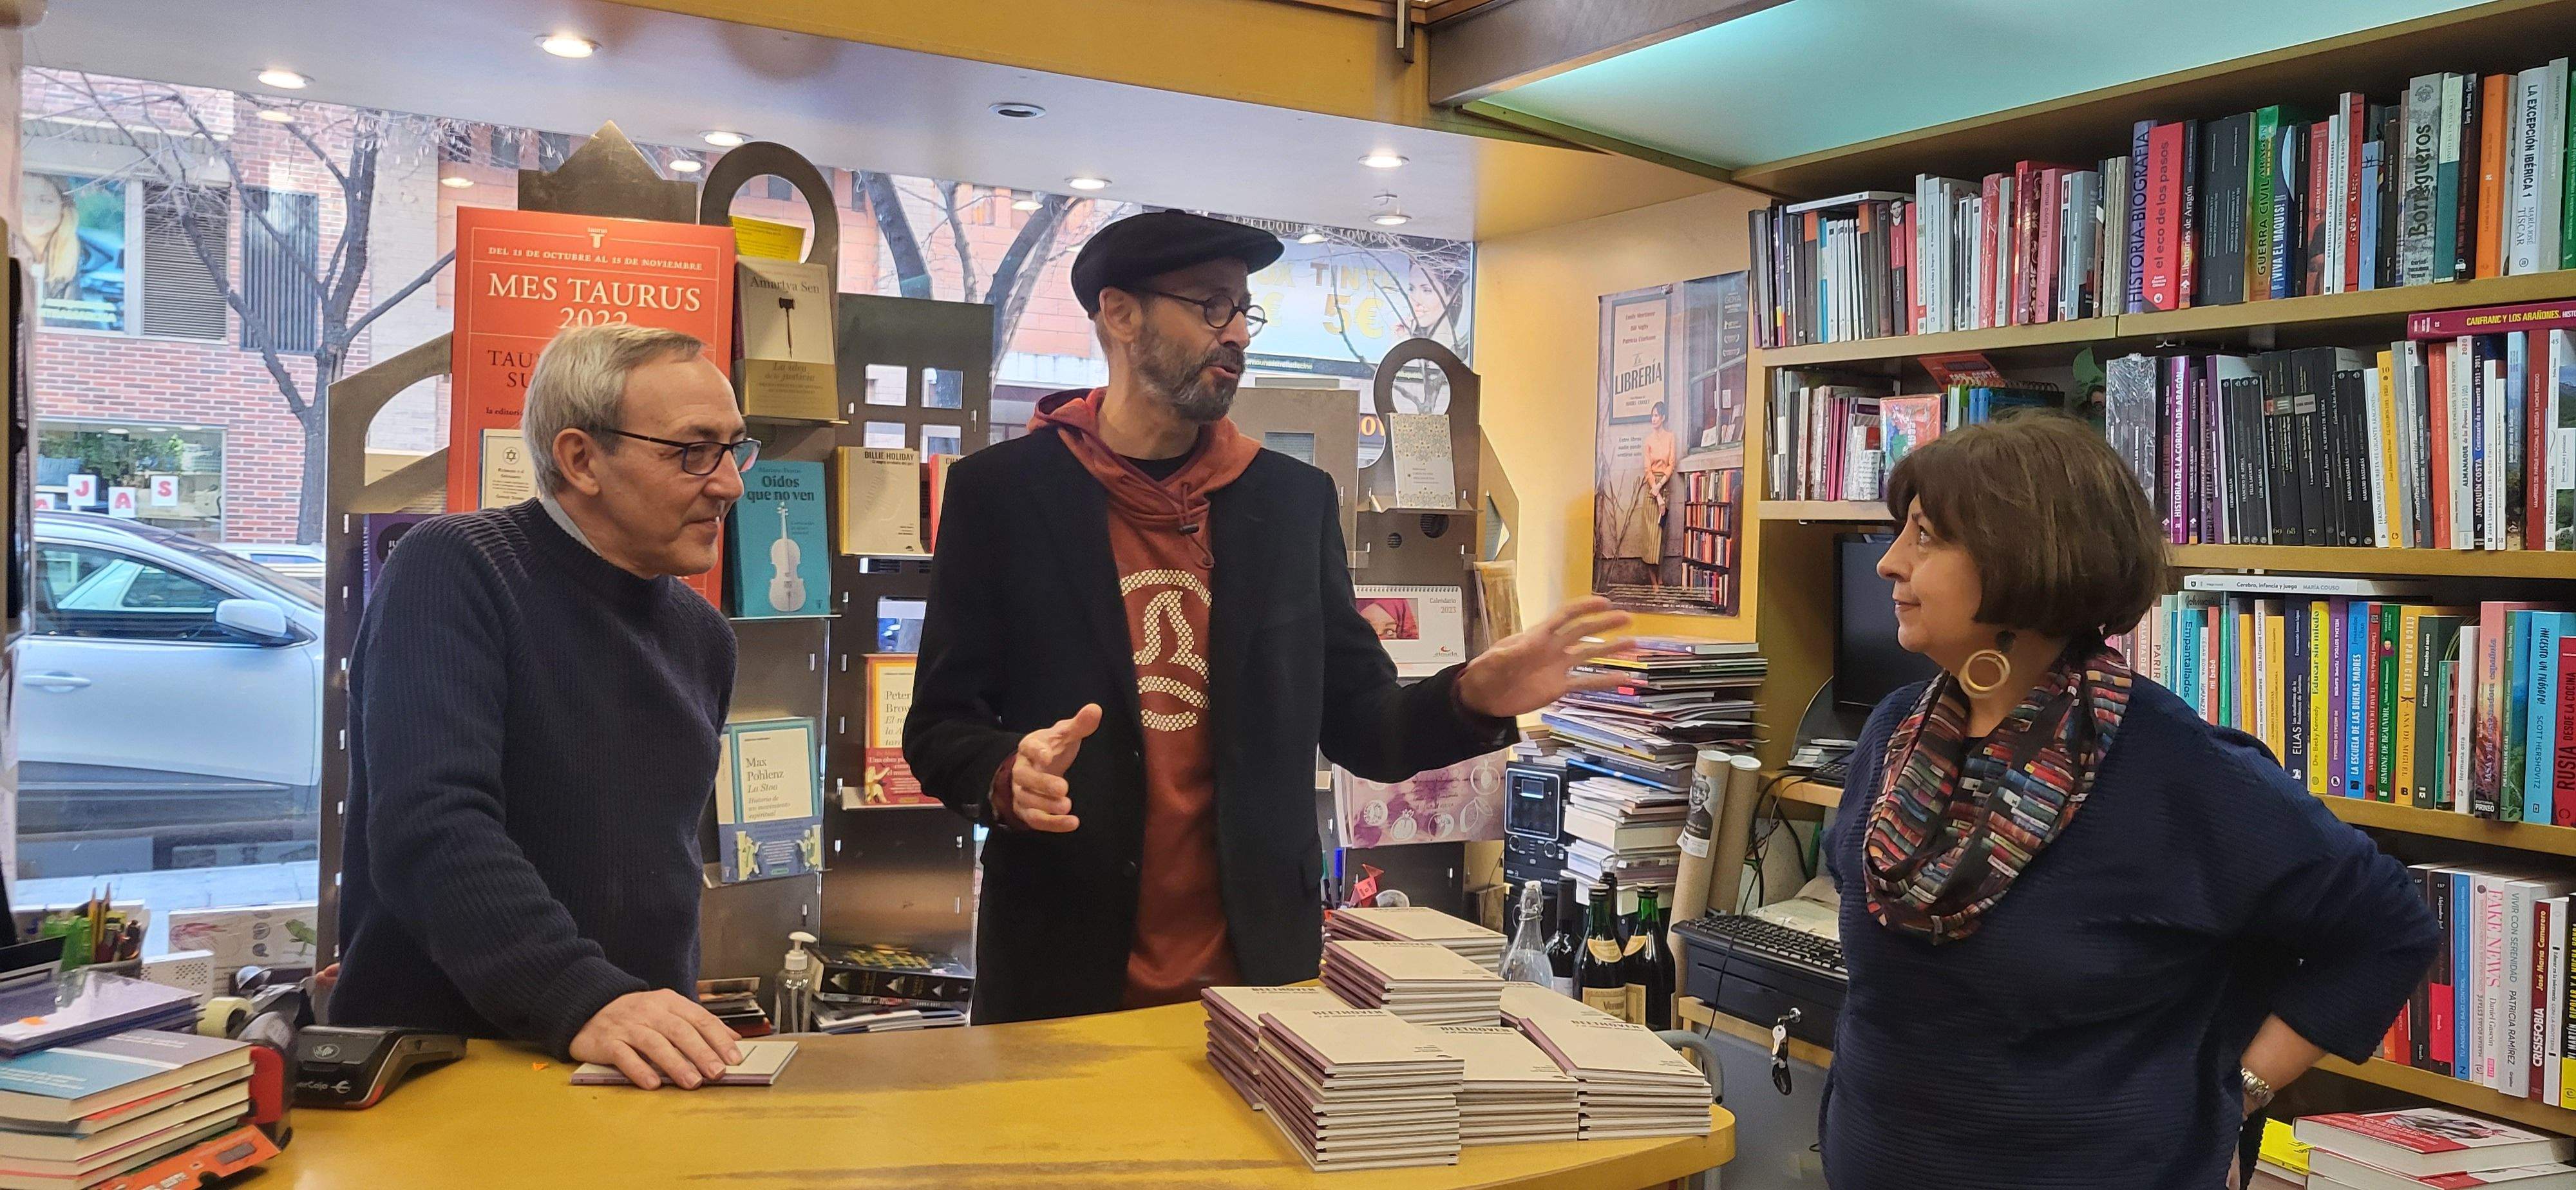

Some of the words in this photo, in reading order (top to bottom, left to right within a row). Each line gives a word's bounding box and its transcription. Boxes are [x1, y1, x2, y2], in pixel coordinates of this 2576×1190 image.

[2527, 84, 2539, 97] LA
[2524, 99, 2538, 151] EXCEPCIÓN
[2159, 141, 2170, 182] pasos
[2259, 126, 2267, 176] ARAGÓN
[2523, 153, 2536, 191] IBÉRICA
[2156, 185, 2167, 205] los
[2184, 185, 2193, 216] Aragón
[2259, 180, 2269, 214] CIVIL
[2128, 131, 2149, 303] HISTORIA-BIOGRAFÍA
[2157, 208, 2166, 225] de
[2184, 218, 2192, 229] de
[2273, 204, 2285, 241] MAQUIS!
[2515, 207, 2526, 246] TÍSCAR
[2156, 228, 2165, 253] eco
[2257, 219, 2268, 275] GUERRA
[2273, 243, 2284, 255] EL
[488, 247, 509, 256] DEL
[526, 249, 540, 258] DE
[543, 251, 591, 262] OCTUBRE
[594, 254, 609, 263] AL
[624, 258, 639, 266] DE
[641, 259, 703, 271] NOVIEMBRE
[2155, 256, 2163, 269] el
[2182, 231, 2192, 276] Libertarios
[2272, 258, 2284, 281] ¡VIVA
[488, 272, 558, 301] MES
[567, 277, 701, 312] TAURUS
[750, 276, 797, 292] Amartya
[800, 280, 820, 294] Sen
[558, 307, 629, 330] 2022
[1615, 359, 1662, 395] LIBRERÍA
[2174, 371, 2183, 410] ARAGÓN
[2175, 411, 2183, 424] DE
[864, 451, 886, 460] BILLIE
[886, 451, 914, 461] HOLIDAY
[2175, 455, 2183, 466] LA
[762, 475, 800, 489] Oídos
[2175, 468, 2182, 479] DE
[74, 481, 90, 496] J
[115, 493, 130, 509] A
[156, 481, 172, 496] S
[747, 489, 771, 504] que
[774, 490, 790, 500] no
[793, 490, 815, 502] ven
[2473, 484, 2483, 518] JOAQUÍN
[2405, 616, 2415, 640] ÉTICA
[2405, 643, 2413, 665] PARA
[2539, 627, 2549, 659] ¡NECESITO
[2141, 657, 2147, 668] DE
[2183, 621, 2193, 698] Empantallados
[2353, 654, 2361, 681] MADRES
[2537, 661, 2547, 671] UN
[2210, 680, 2216, 690] mi
[2403, 668, 2412, 692] CELIA
[2536, 674, 2548, 705] FILÓSOFO!
[2564, 672, 2575, 701] COCINA
[886, 691, 912, 701] Peter
[2352, 683, 2360, 710] BUENAS
[2564, 703, 2574, 713] LA
[2351, 712, 2360, 724] LAS
[2351, 726, 2360, 734] DE
[2535, 715, 2544, 740] SCOTT
[2563, 715, 2573, 741] DESDE
[2292, 726, 2302, 755] ELLAS
[2403, 731, 2409, 742] DE
[746, 757, 767, 768] Max
[2350, 736, 2359, 764] ESCUELA
[747, 770, 784, 780] Pohlenz
[2533, 742, 2542, 789] HERSHOVITZ
[2556, 746, 2575, 791] RUSIA
[2475, 803, 2495, 812] PIRINEO
[2486, 889, 2503, 932] FAKE
[2510, 893, 2519, 913] VIVIR
[2510, 914, 2519, 934] CON
[2537, 910, 2546, 948] Camarero
[2486, 936, 2501, 988] NEWS
[2509, 937, 2518, 983] SERENIDAD
[2537, 950, 2545, 972] María
[2536, 974, 2544, 991] José
[2488, 997, 2497, 1019] Daniel
[2508, 990, 2517, 1028] PATRICIA
[2487, 1021, 2496, 1046] Gascón
[2532, 1008, 2544, 1067] CRISISFOBIA
[2507, 1029, 2517, 1065] RAMÍREZ
